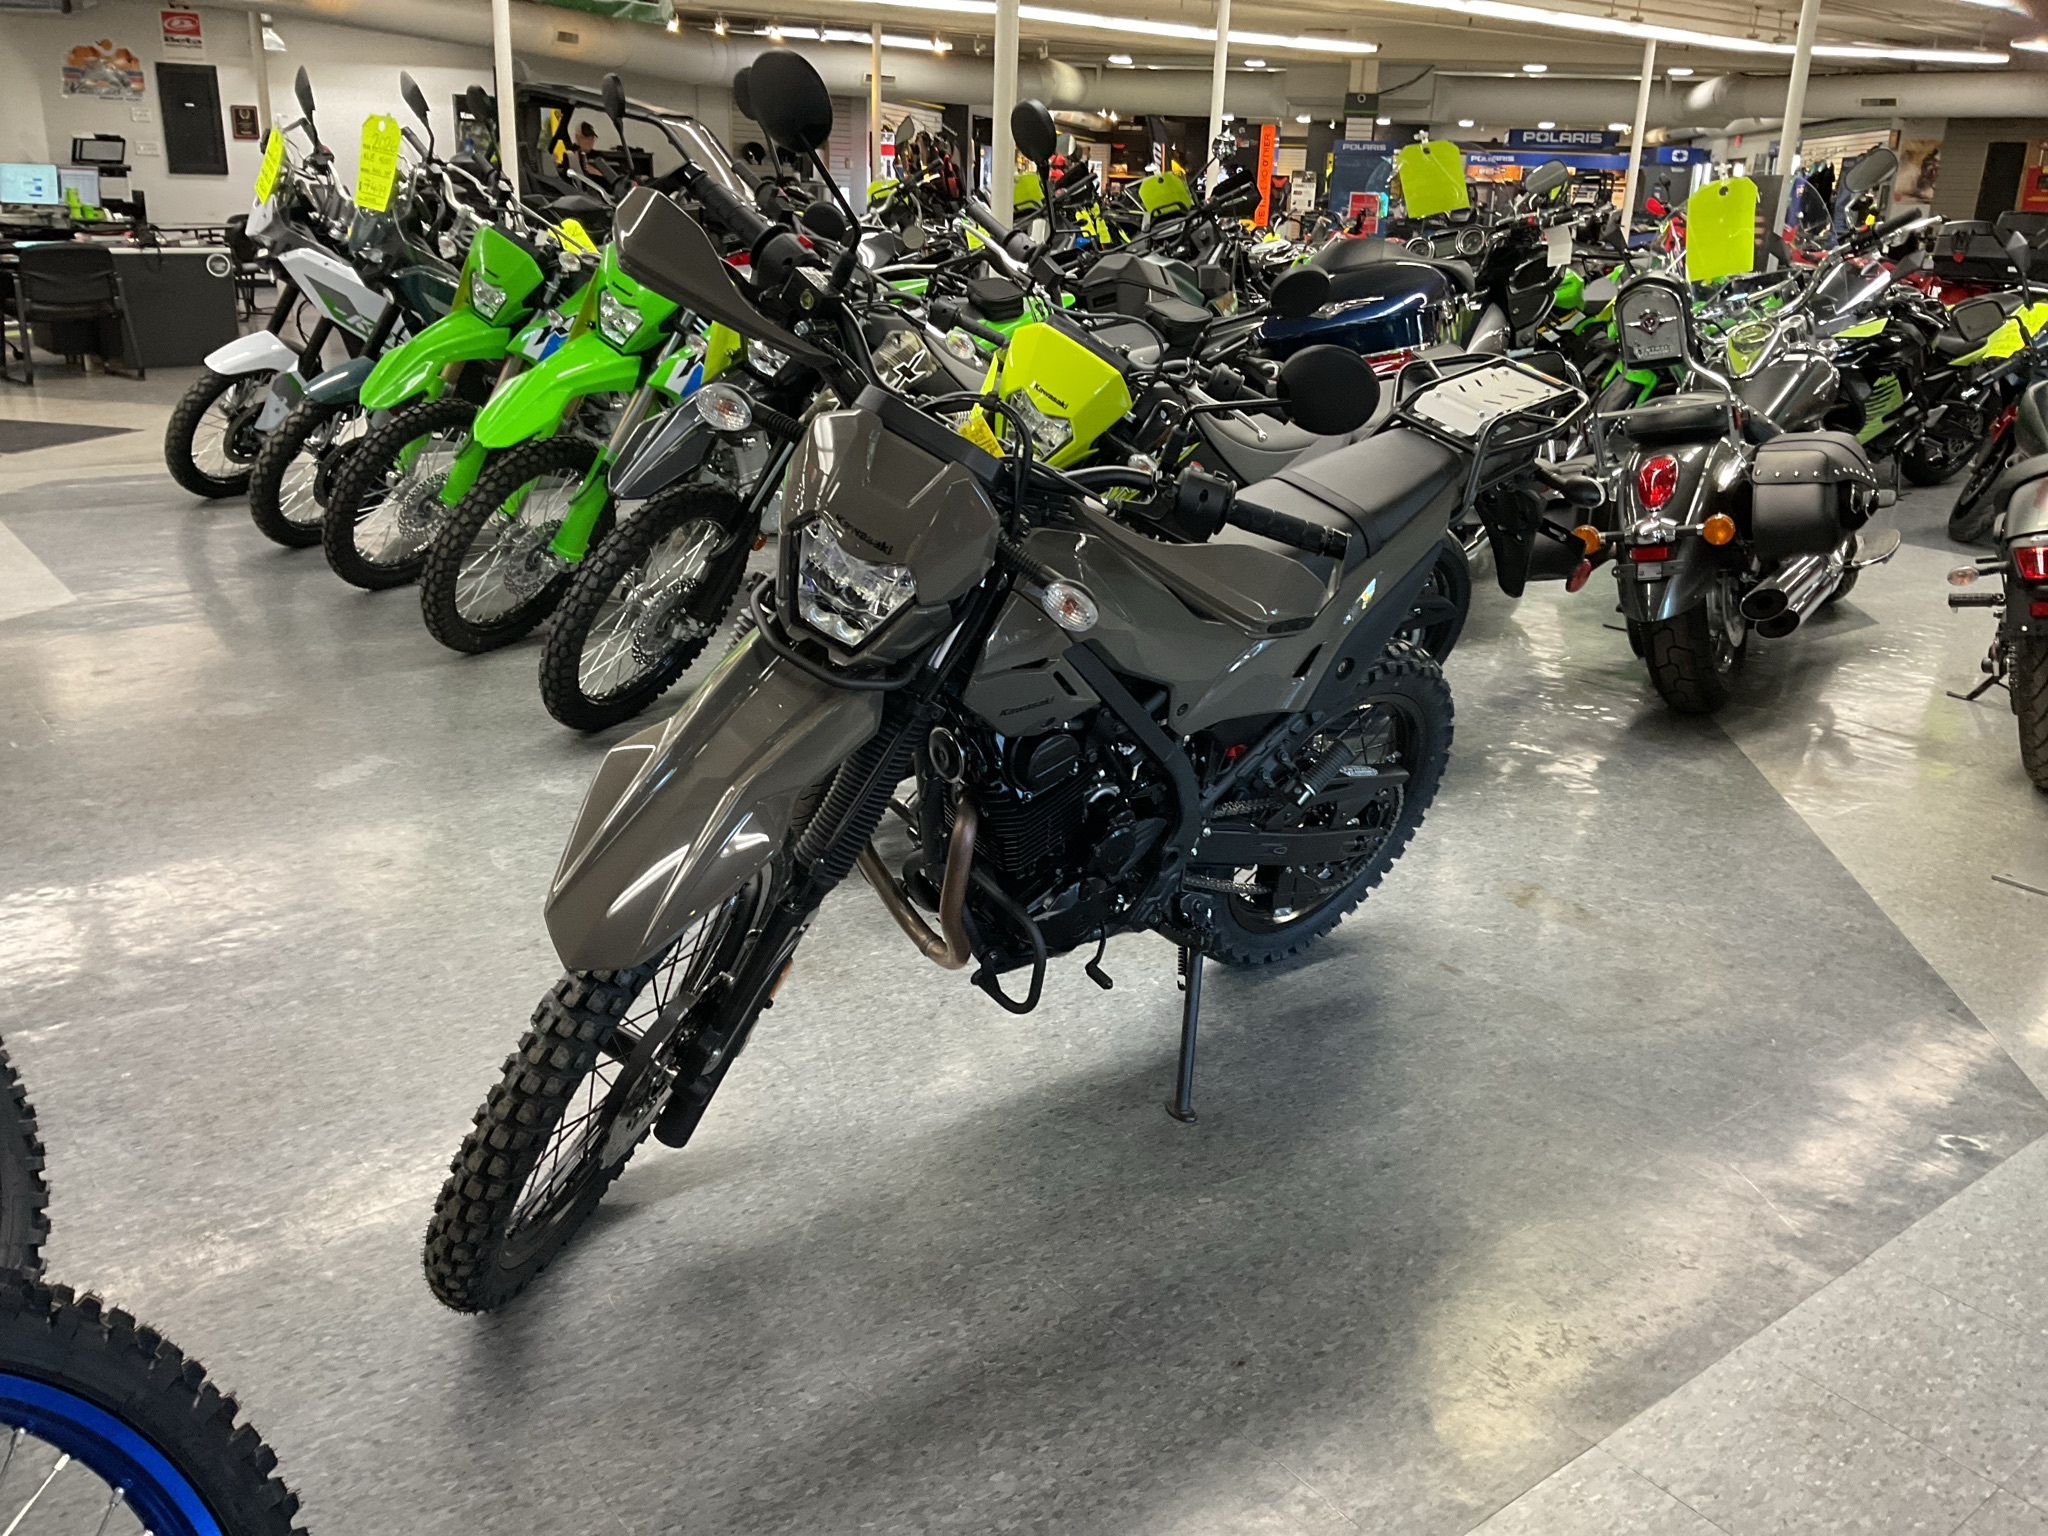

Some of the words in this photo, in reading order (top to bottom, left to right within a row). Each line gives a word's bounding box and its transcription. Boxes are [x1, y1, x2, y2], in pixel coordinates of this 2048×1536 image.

[1523, 131, 1602, 143] POLARIS
[1342, 143, 1387, 151] POLARIS
[1471, 154, 1515, 162] POLARIS
[1034, 382, 1069, 410] Kawasaki
[835, 513, 894, 556] Kawasaki
[999, 695, 1056, 718] Kawasaki
